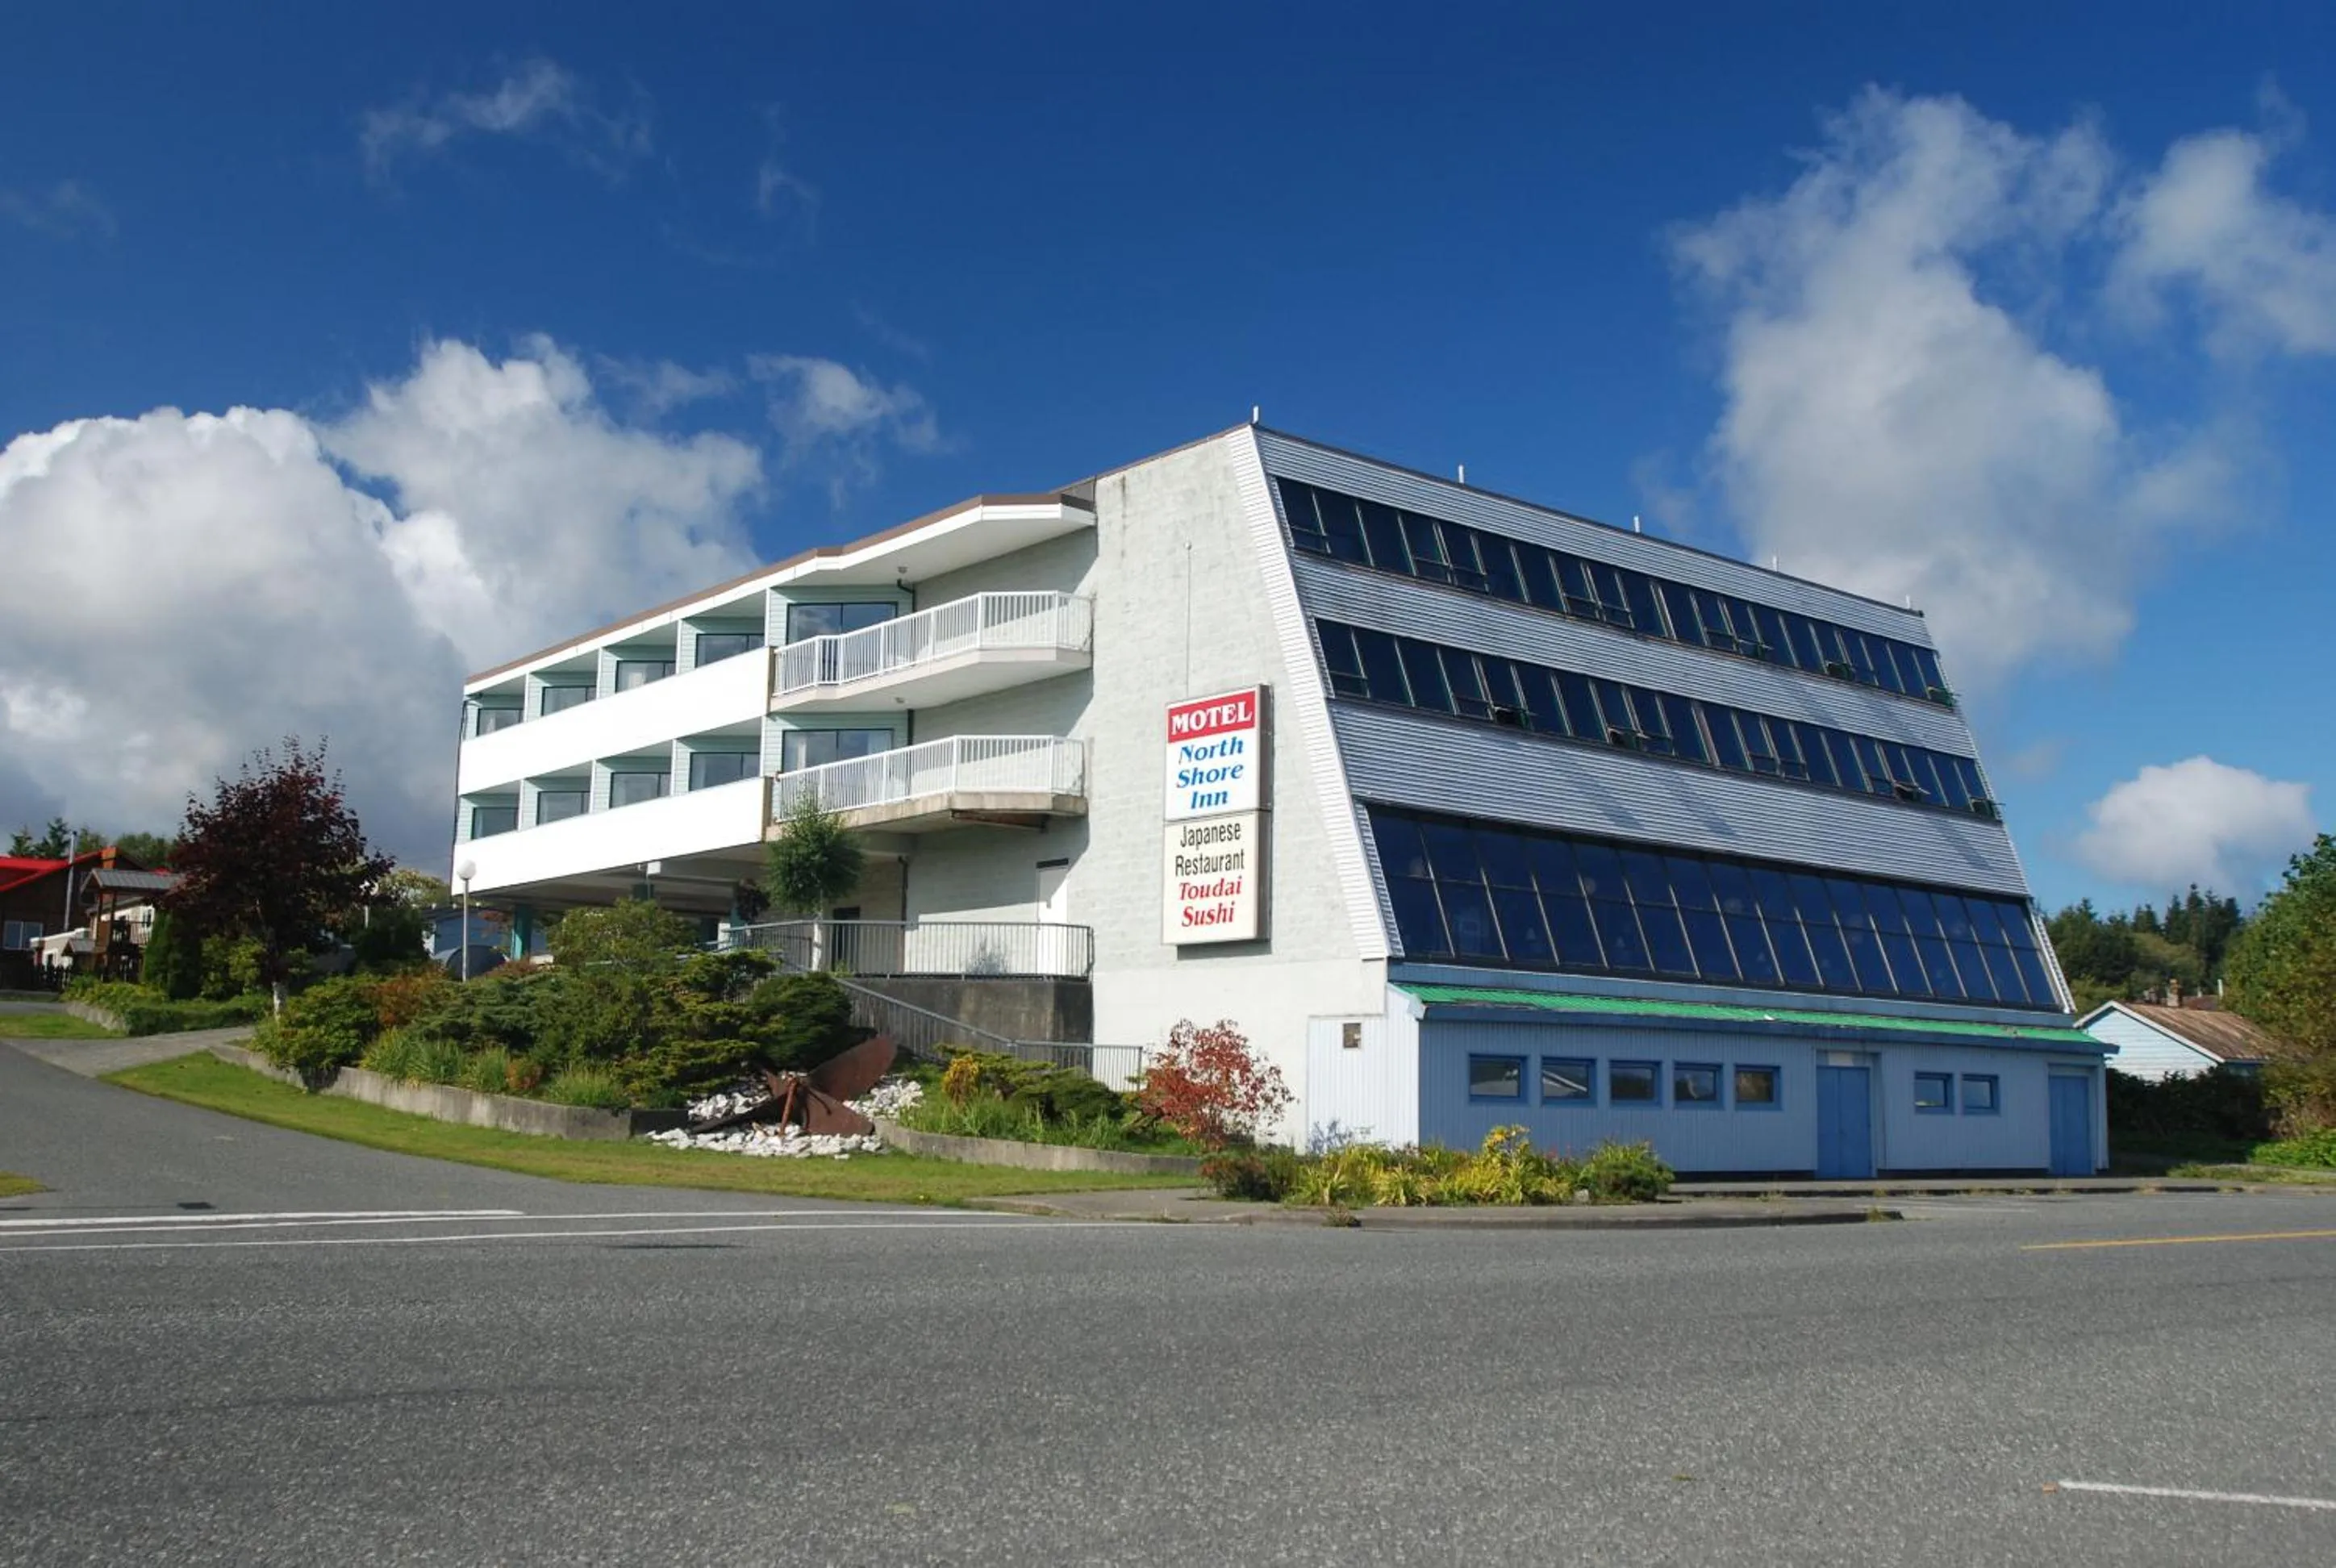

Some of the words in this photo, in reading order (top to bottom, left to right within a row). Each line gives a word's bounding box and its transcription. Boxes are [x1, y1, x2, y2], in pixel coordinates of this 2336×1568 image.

[1171, 701, 1253, 736] MOTEL
[1178, 736, 1243, 765] North
[1176, 764, 1244, 789] Shore
[1191, 790, 1228, 809] Inn
[1180, 823, 1241, 851] Japanese
[1175, 849, 1245, 877] Restaurant
[1178, 876, 1242, 901] Toudai
[1182, 901, 1235, 928] Sushi
